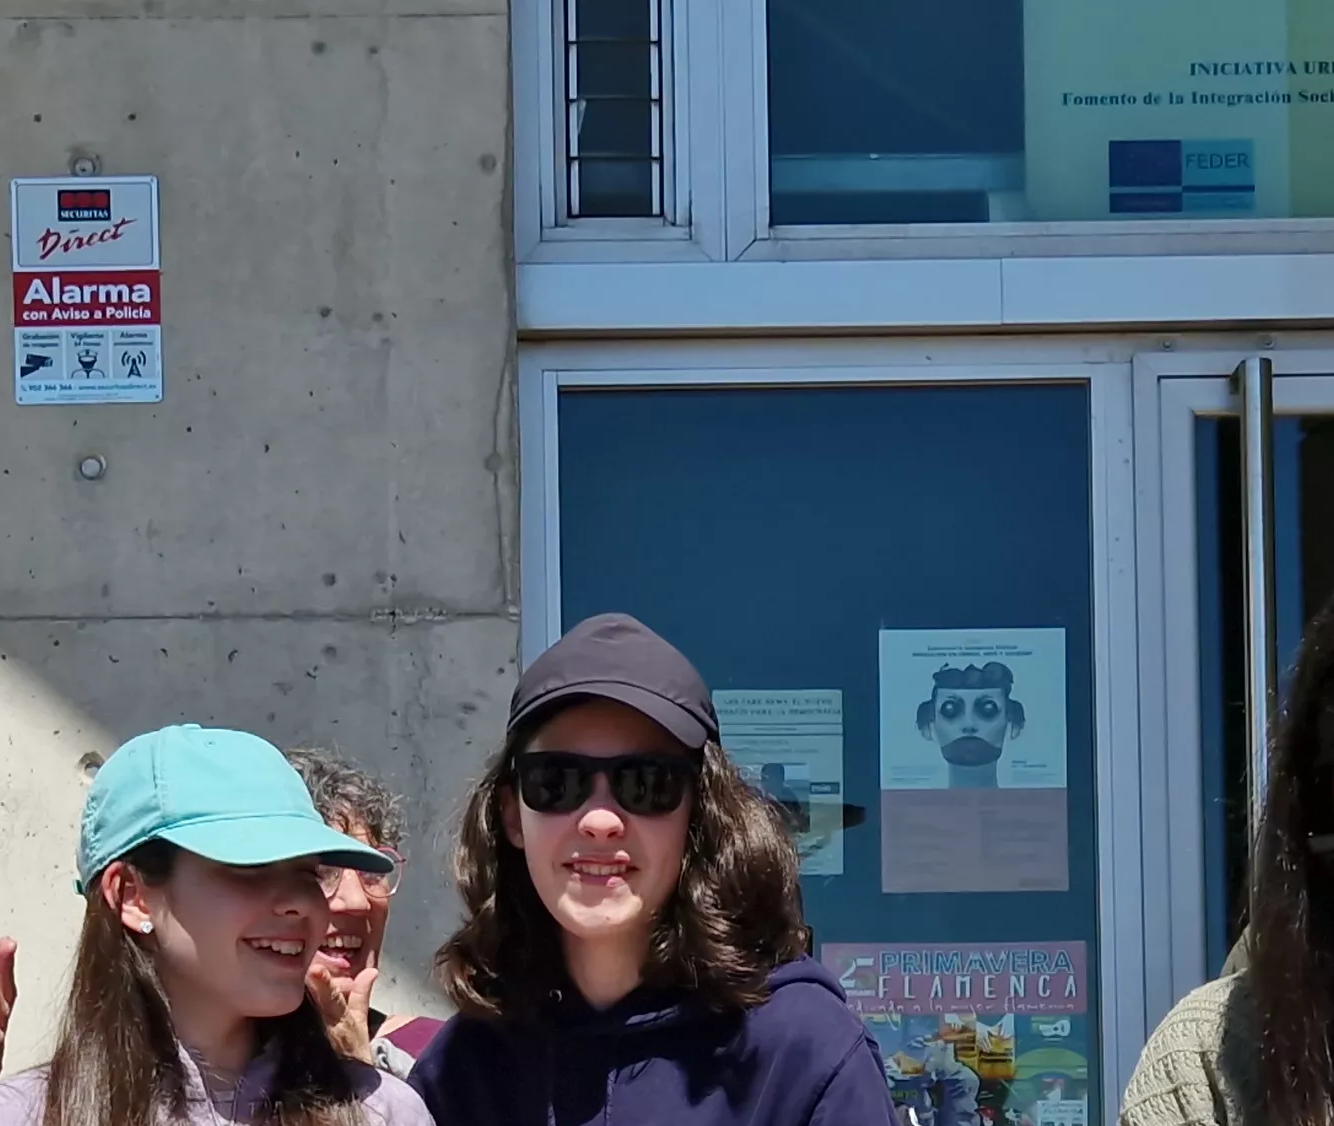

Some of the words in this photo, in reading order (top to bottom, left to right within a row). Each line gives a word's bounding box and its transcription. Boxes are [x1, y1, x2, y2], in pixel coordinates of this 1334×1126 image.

[1190, 61, 1297, 76] INICIATIVA
[1061, 91, 1138, 106] Fomento
[1143, 91, 1162, 105] de
[1168, 91, 1184, 105] la
[1191, 88, 1291, 107] Integración
[1186, 152, 1250, 170] FEDER
[60, 210, 109, 219] SECURITAS
[37, 218, 138, 260] Direct
[23, 276, 151, 305] Alarma
[23, 310, 47, 321] con
[51, 307, 90, 320] Aviso
[93, 310, 102, 320] a
[106, 306, 152, 320] Policía
[878, 950, 1075, 975] PRIMAVERA
[878, 975, 1077, 999] FLAMENCA
